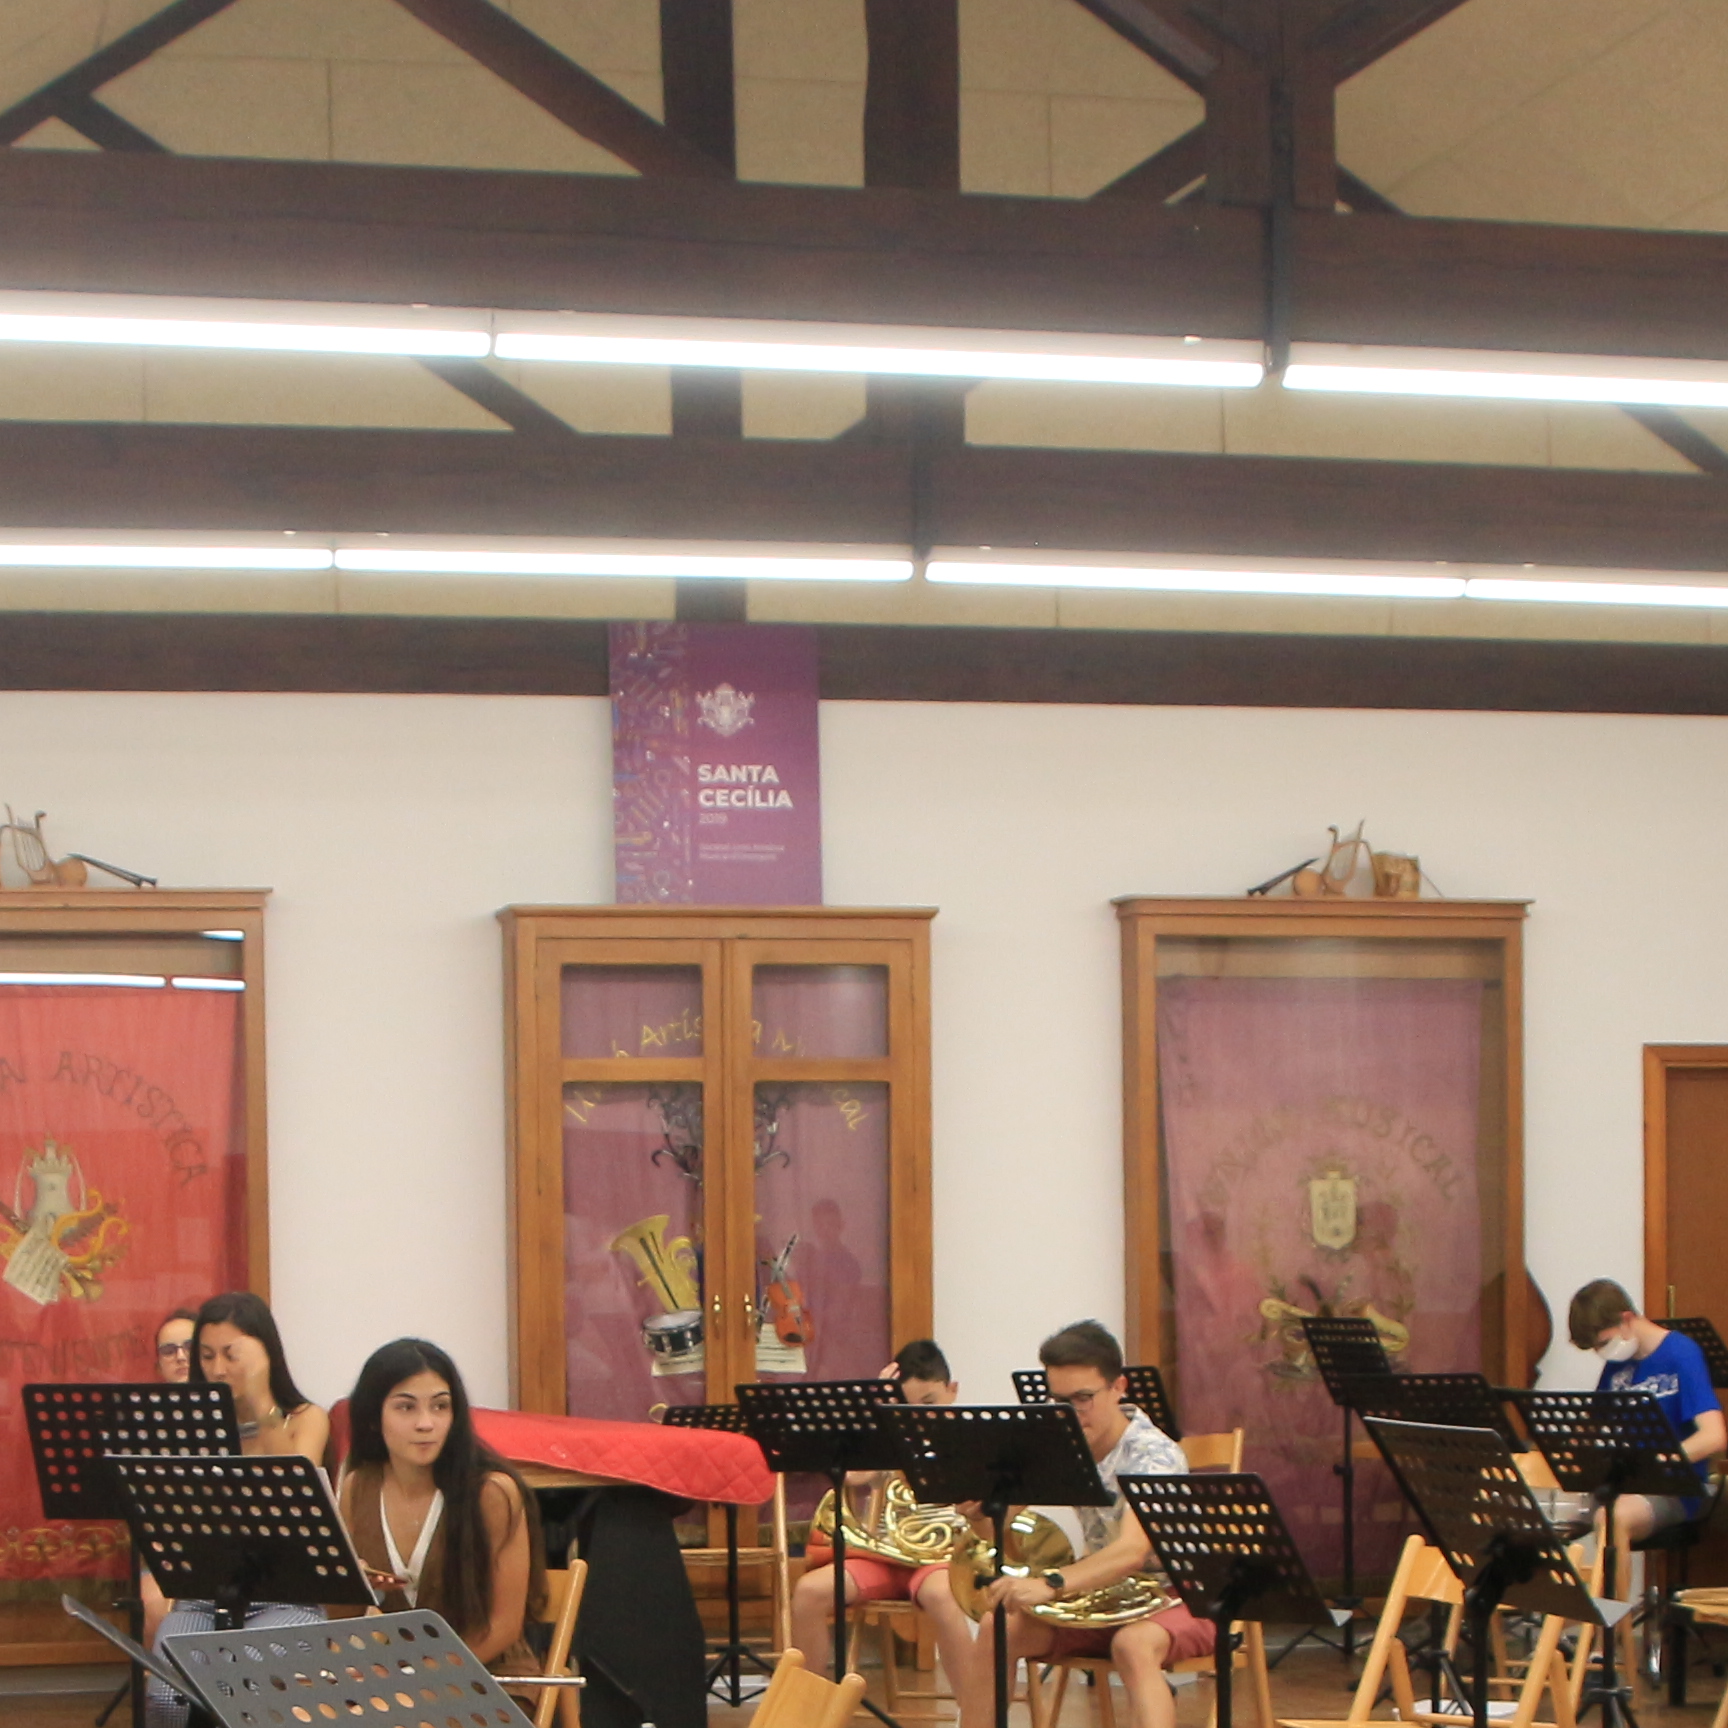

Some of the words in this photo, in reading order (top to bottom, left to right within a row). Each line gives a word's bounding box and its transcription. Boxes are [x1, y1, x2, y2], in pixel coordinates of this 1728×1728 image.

[697, 764, 779, 783] SANTA
[698, 785, 793, 808] CECÍLIA
[52, 1050, 208, 1187] ARTISTICA
